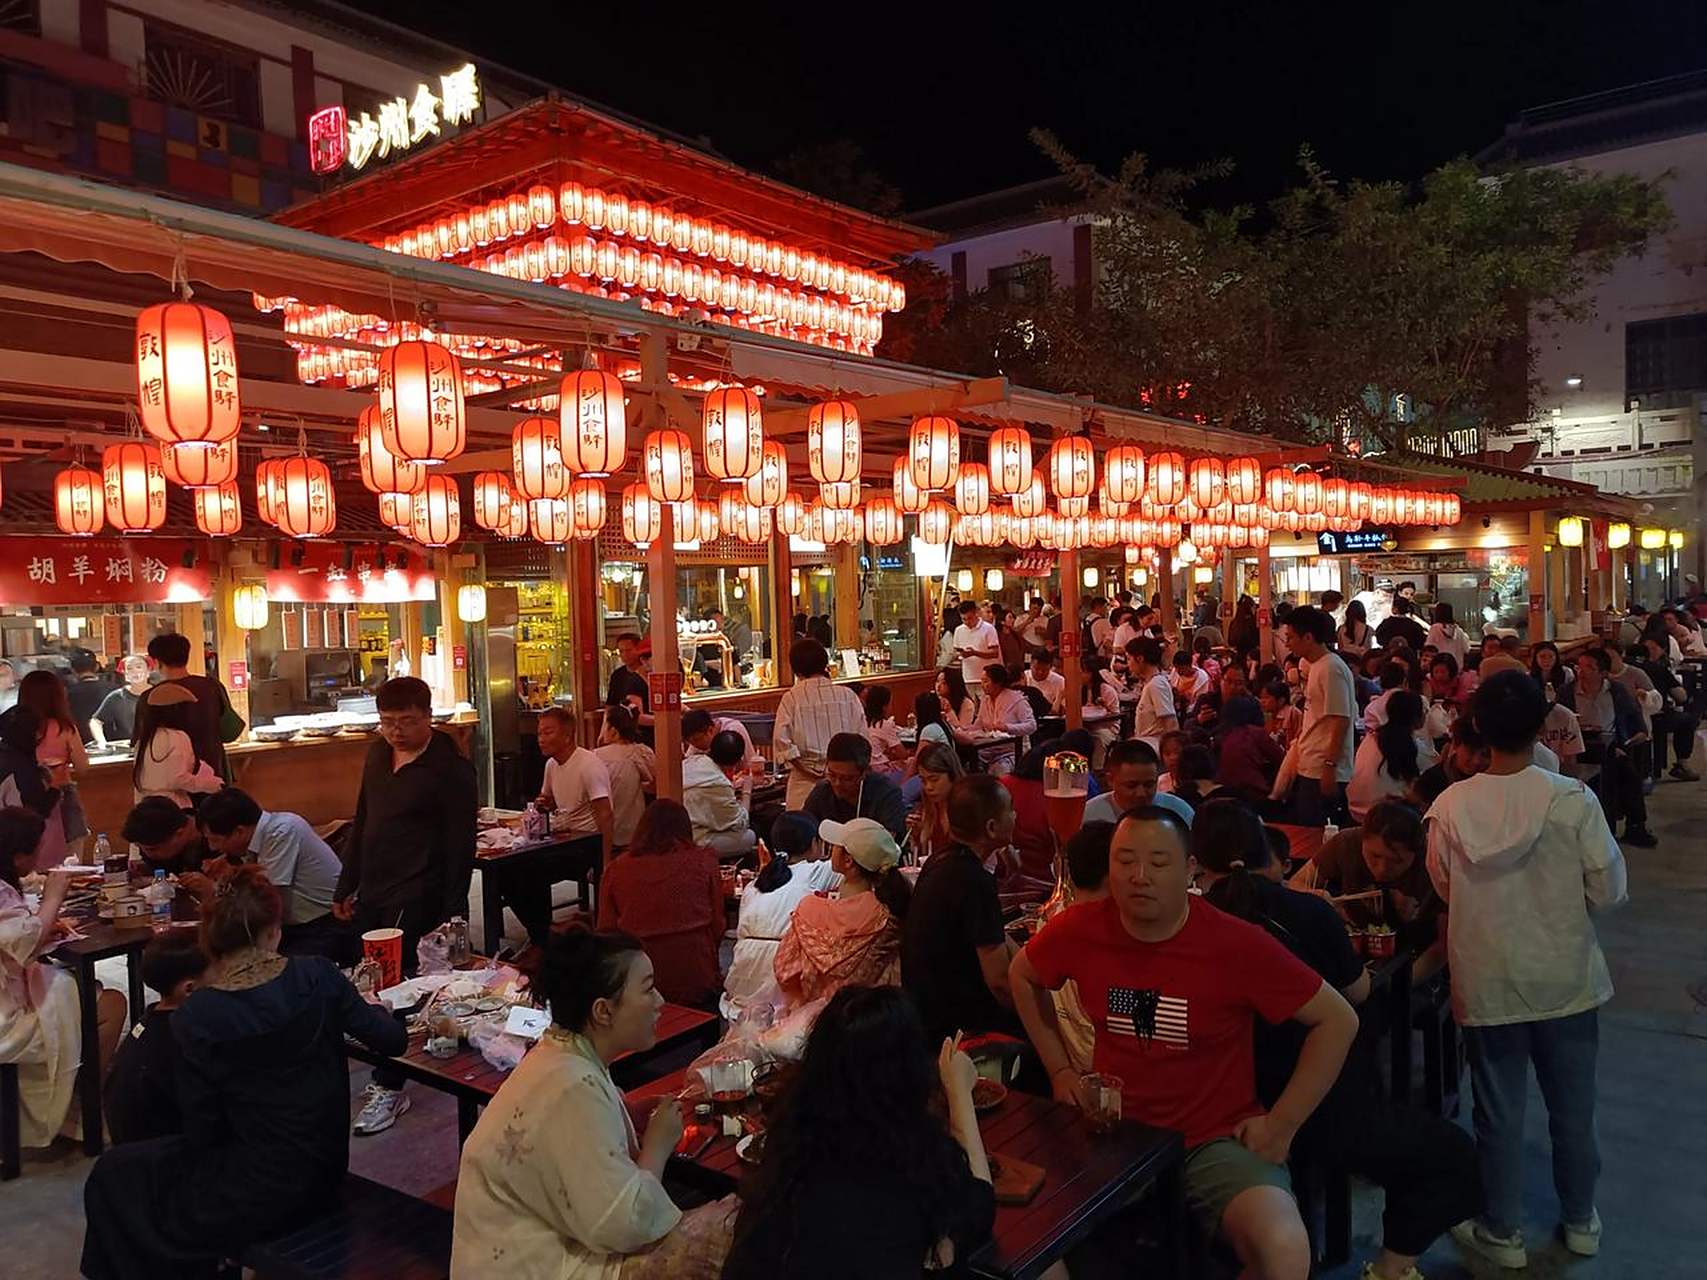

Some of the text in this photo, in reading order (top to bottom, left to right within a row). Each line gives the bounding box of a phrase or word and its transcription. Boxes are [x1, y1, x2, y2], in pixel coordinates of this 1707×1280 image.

[139, 332, 162, 406] 敦煌
[208, 330, 236, 411] 沙州食驿
[430, 361, 454, 431] 沙州食驿
[582, 386, 604, 449] 沙州食驿
[708, 409, 722, 457] 敦煌
[149, 462, 164, 509] 敦煌
[27, 555, 169, 585] 胡羊焖粉
